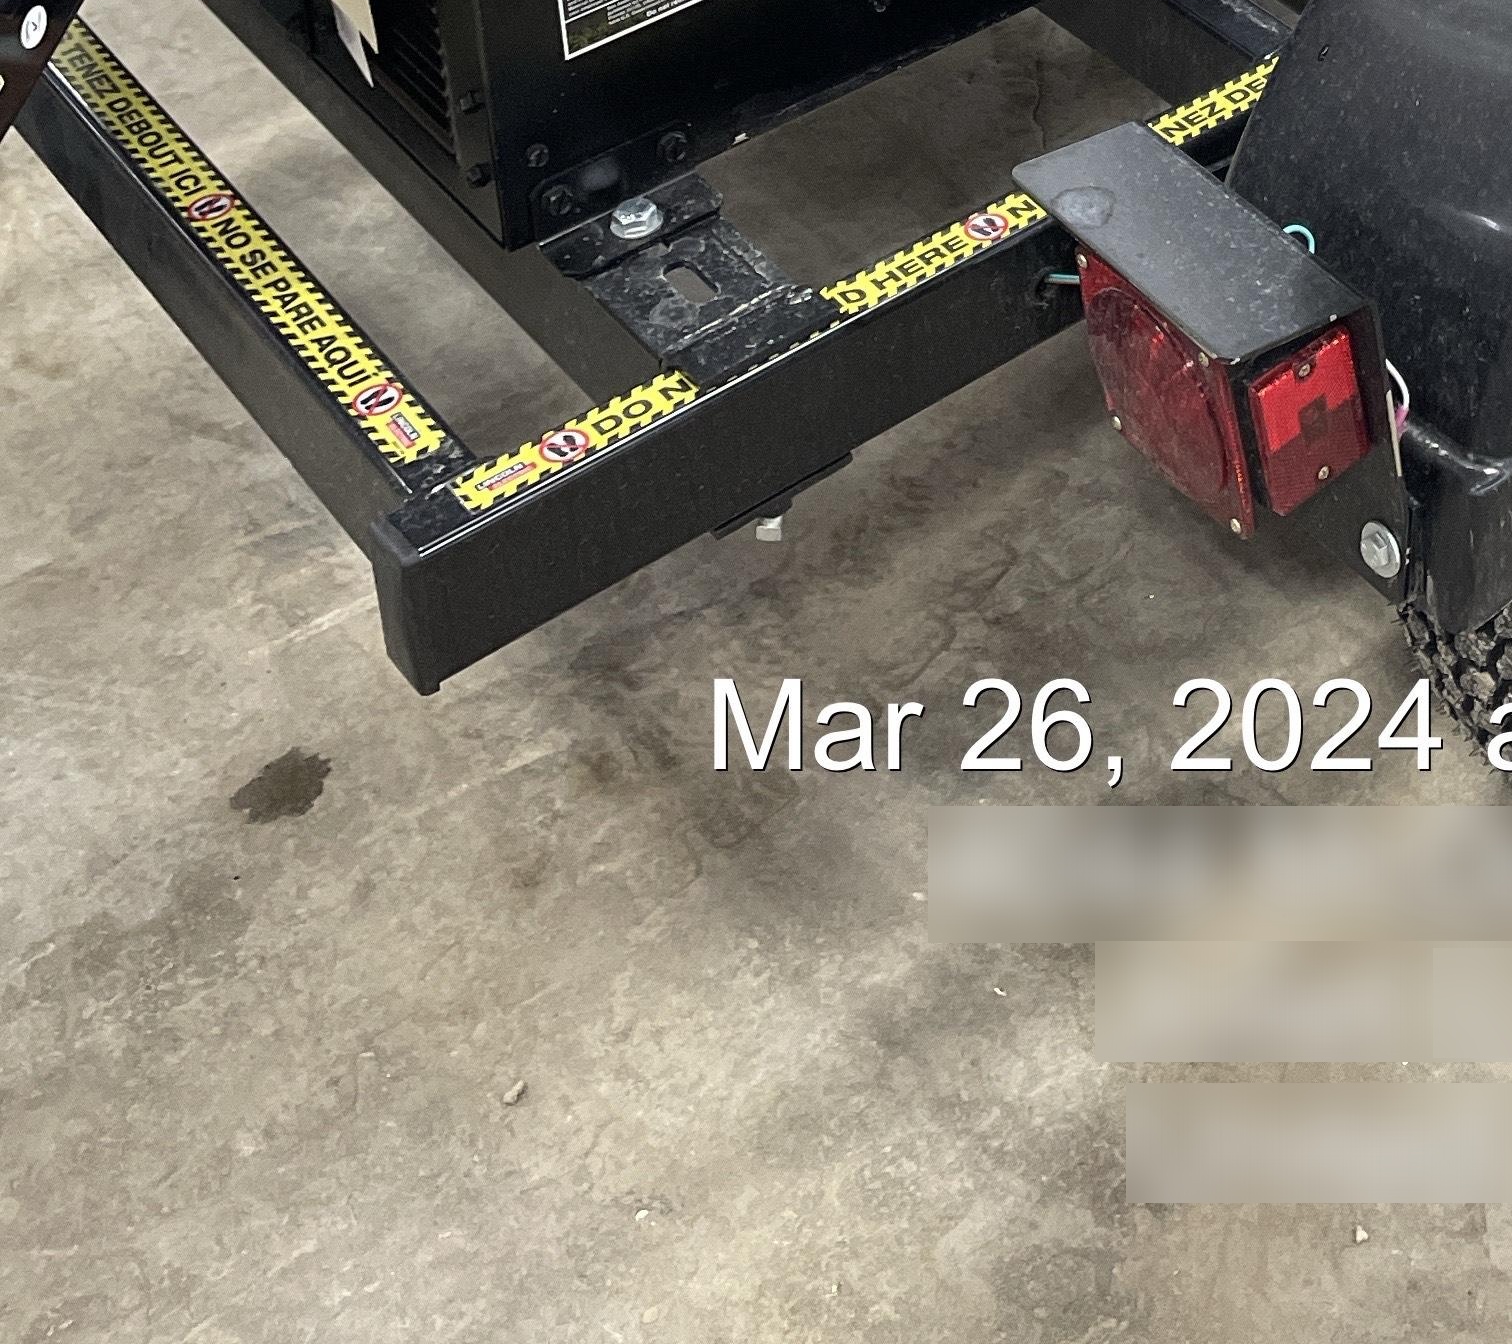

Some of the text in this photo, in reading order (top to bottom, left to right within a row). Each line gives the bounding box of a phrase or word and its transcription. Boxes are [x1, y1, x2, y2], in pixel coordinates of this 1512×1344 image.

[61, 42, 208, 197] TENEZ DEBOUT ICI
[1160, 100, 1226, 139] NEZ
[211, 216, 252, 251] NO
[239, 248, 279, 281] SE
[263, 275, 328, 335] PARE
[871, 235, 970, 291] HERE
[591, 399, 653, 436] DO
